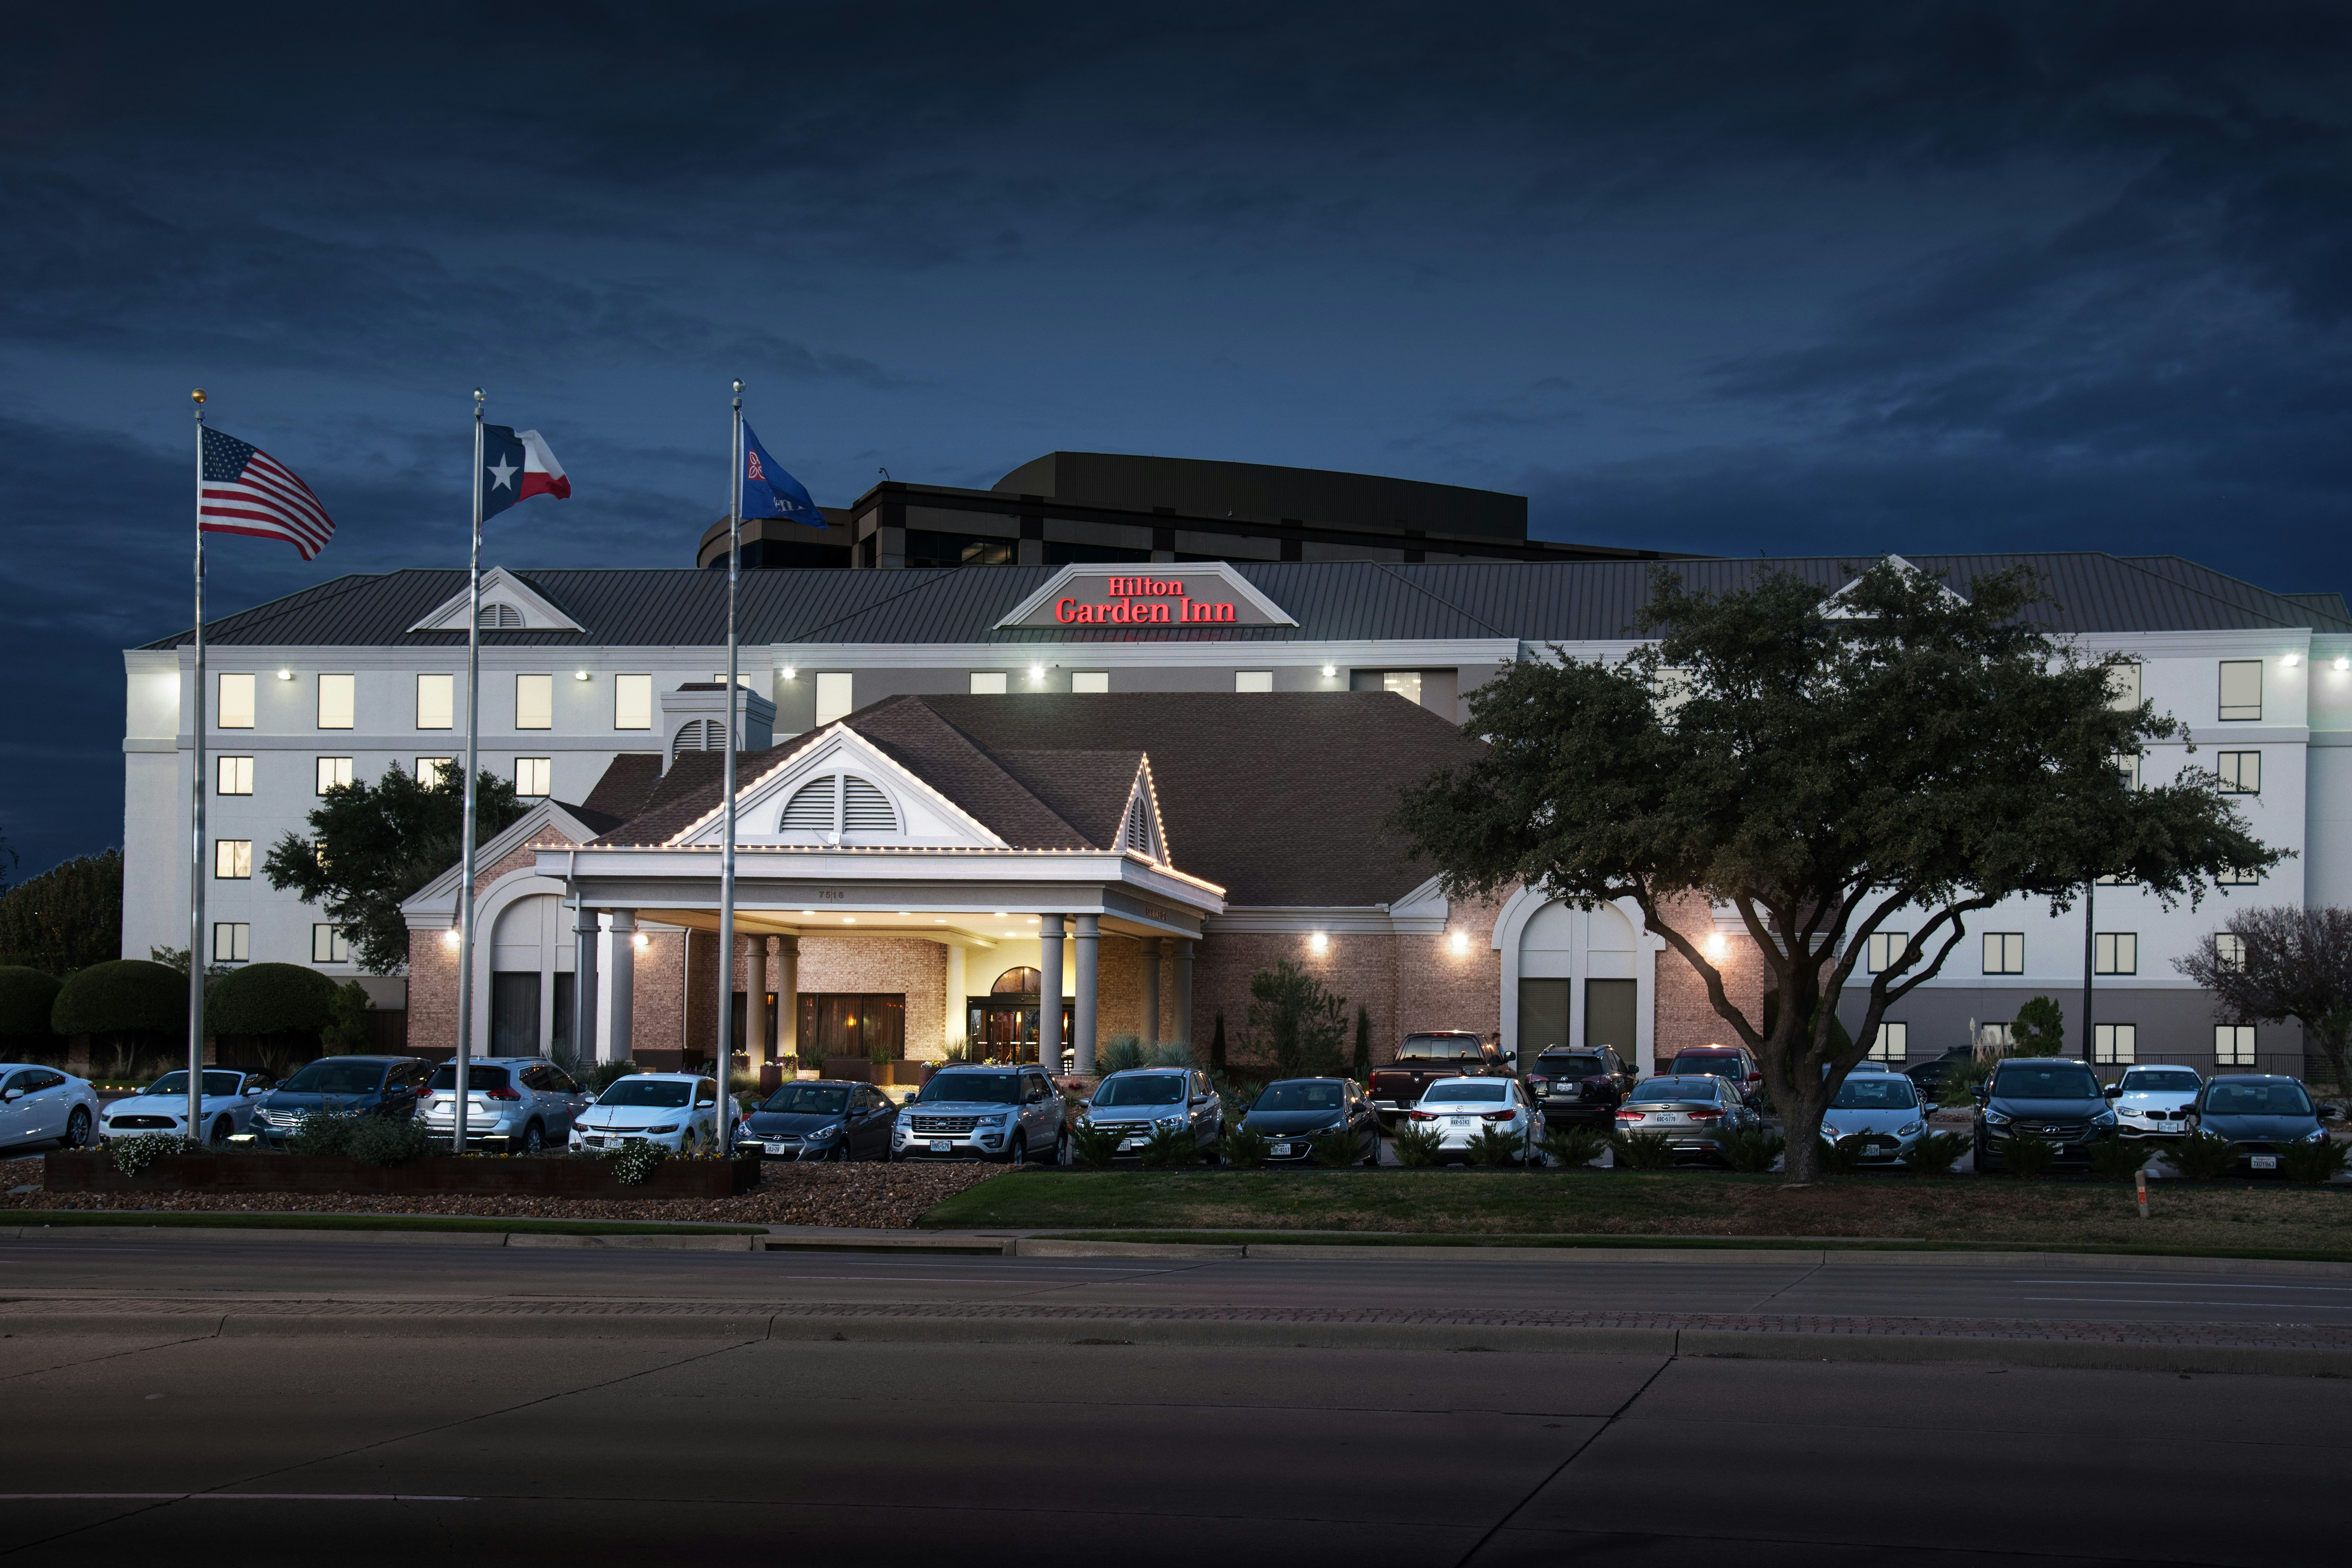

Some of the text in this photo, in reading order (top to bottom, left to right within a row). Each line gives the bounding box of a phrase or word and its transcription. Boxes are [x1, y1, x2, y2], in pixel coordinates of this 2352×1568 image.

[1108, 577, 1183, 596] Hilton
[1055, 597, 1236, 623] Garden Inn
